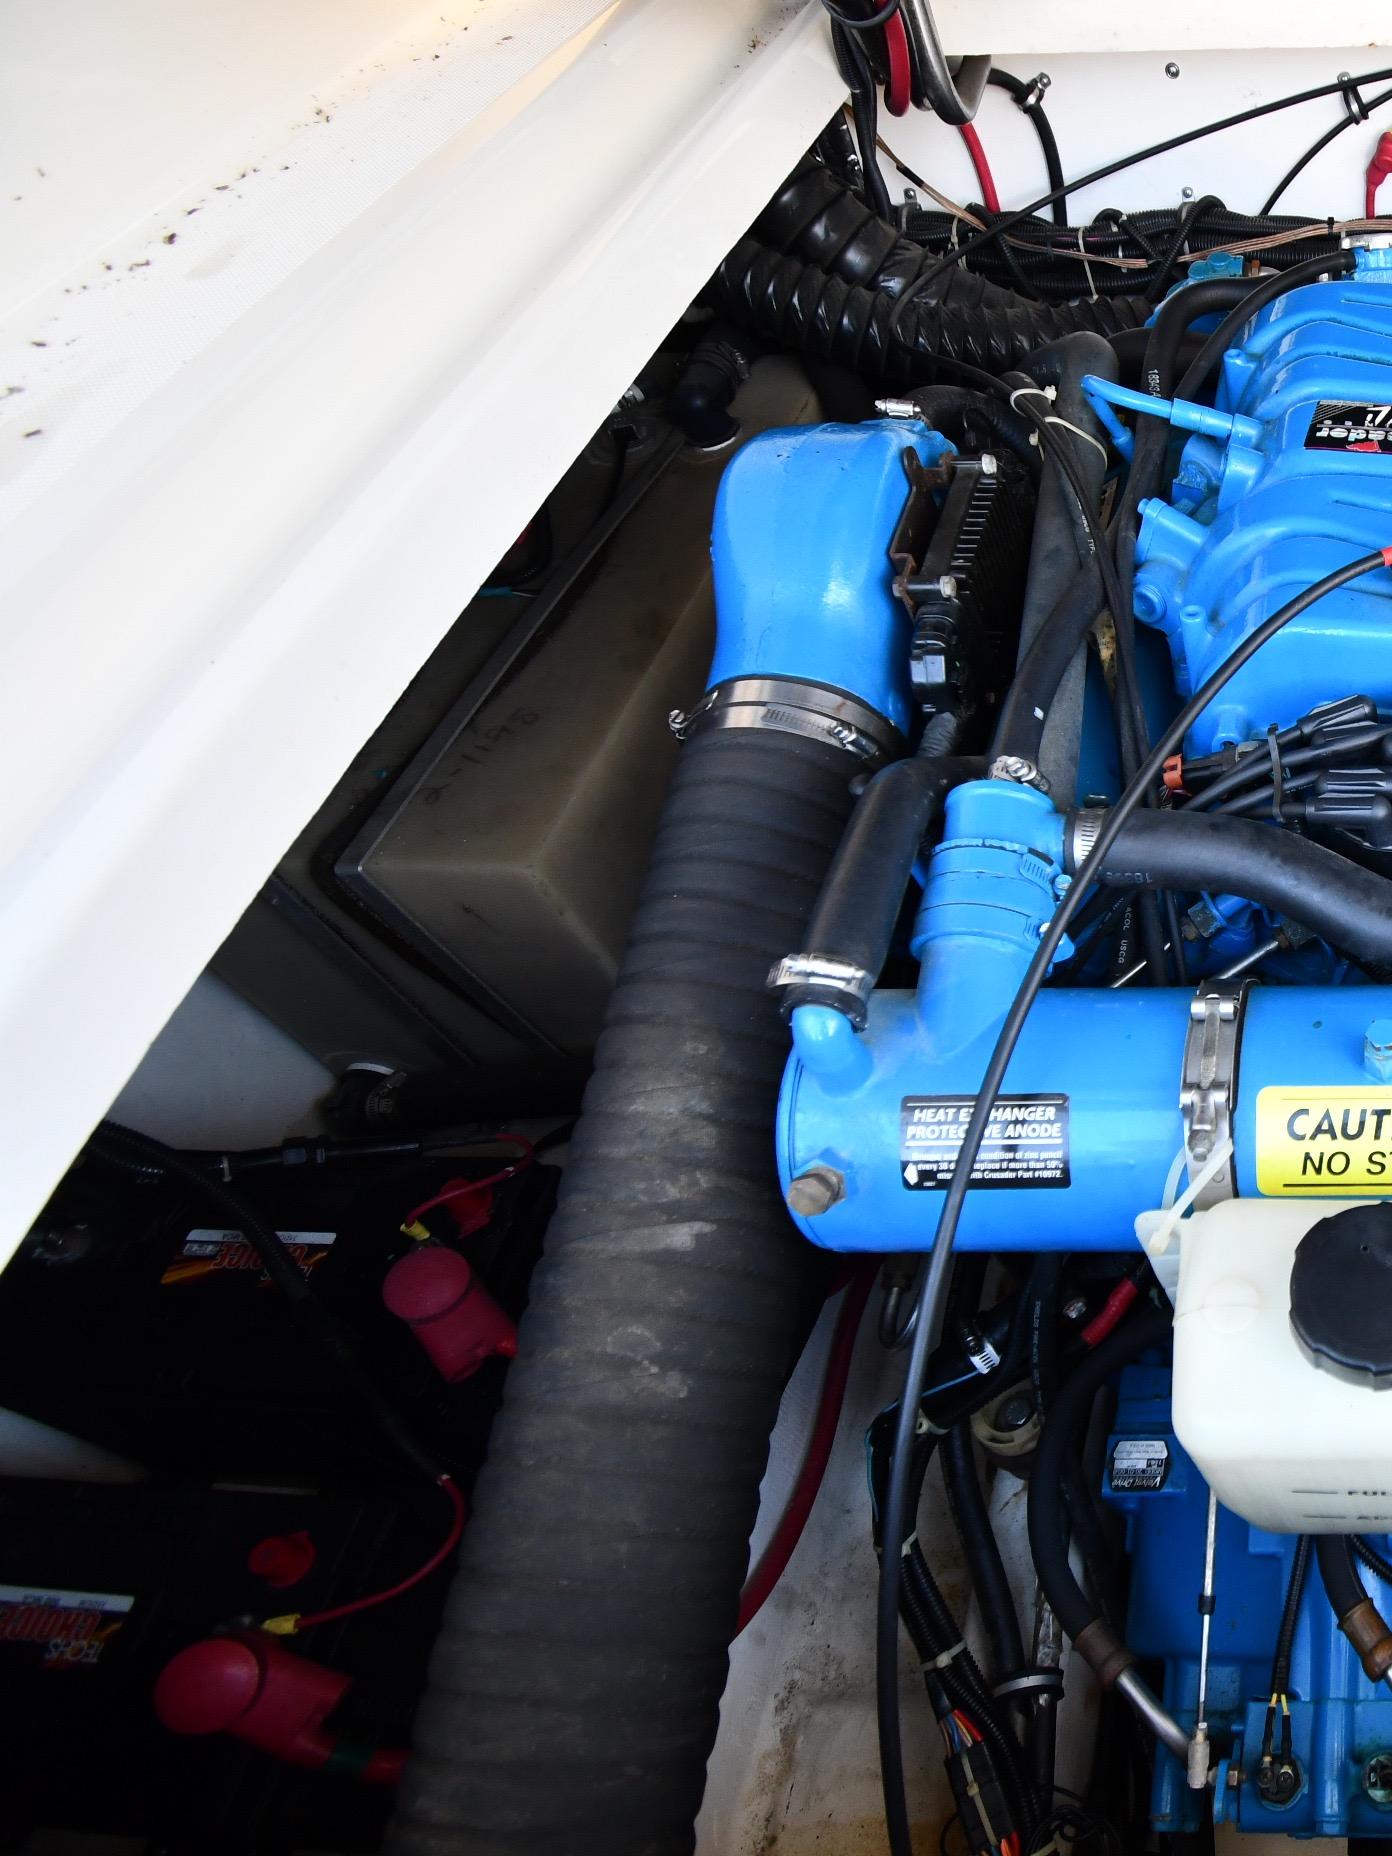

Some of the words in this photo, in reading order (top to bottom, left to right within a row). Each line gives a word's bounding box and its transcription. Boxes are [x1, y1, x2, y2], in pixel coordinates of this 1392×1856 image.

[913, 1108, 957, 1123] HEAT
[959, 1106, 1056, 1122] EHANGER
[906, 1124, 1001, 1139] PROTECVE
[1004, 1123, 1062, 1138] ANODE
[1301, 1151, 1351, 1176] NO
[984, 1171, 1017, 1180] Crusader
[1112, 1479, 1134, 1488] Drive
